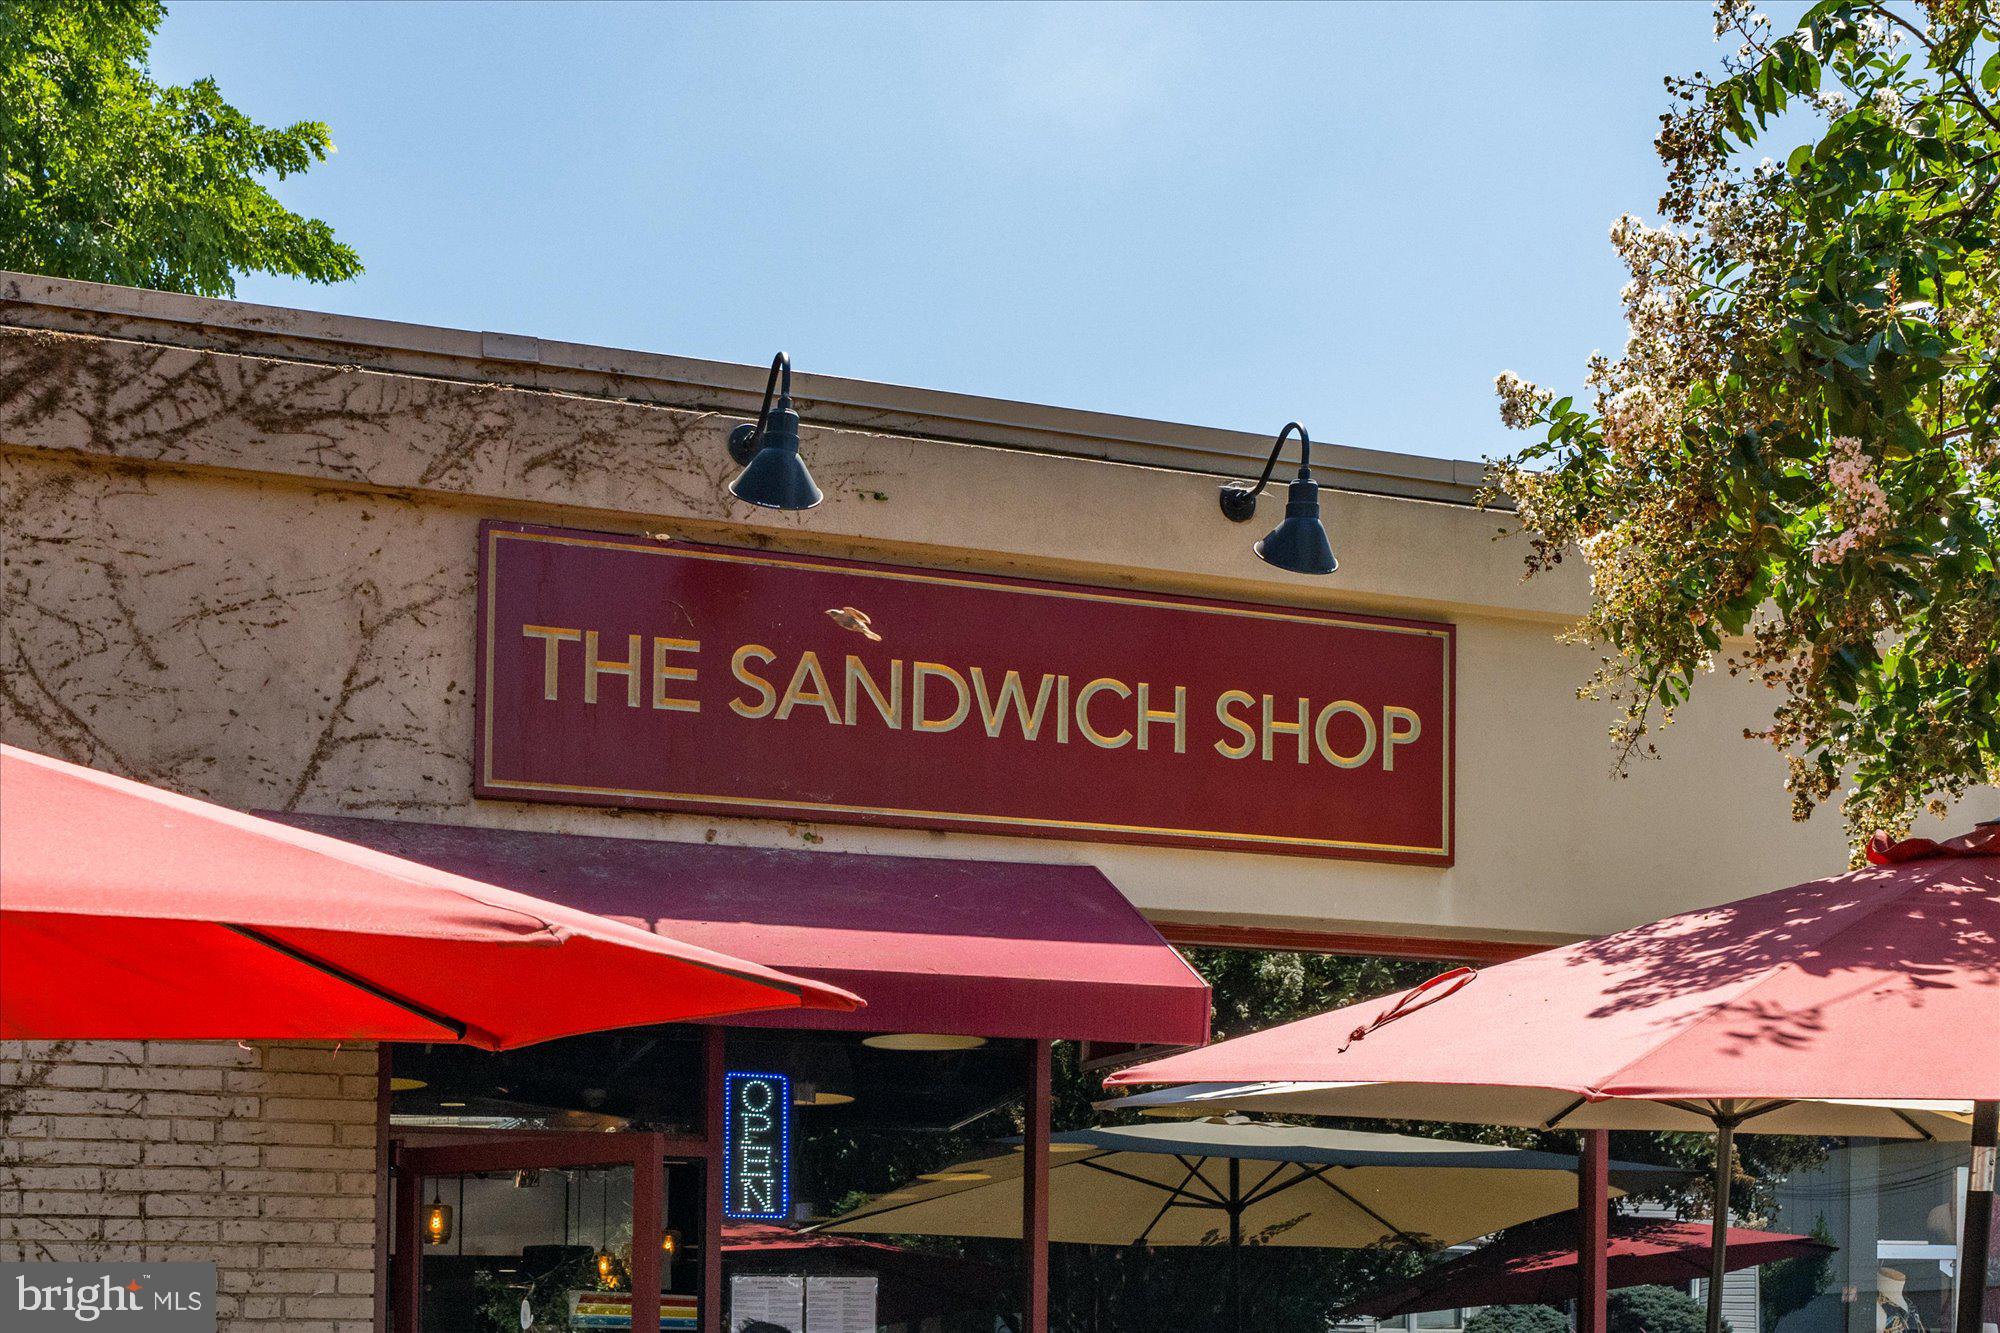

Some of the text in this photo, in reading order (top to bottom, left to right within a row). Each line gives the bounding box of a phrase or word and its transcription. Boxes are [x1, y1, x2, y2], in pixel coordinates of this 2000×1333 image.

[522, 624, 1422, 772] THE SANDWICH SHOP
[740, 1080, 775, 1213] OPEN
